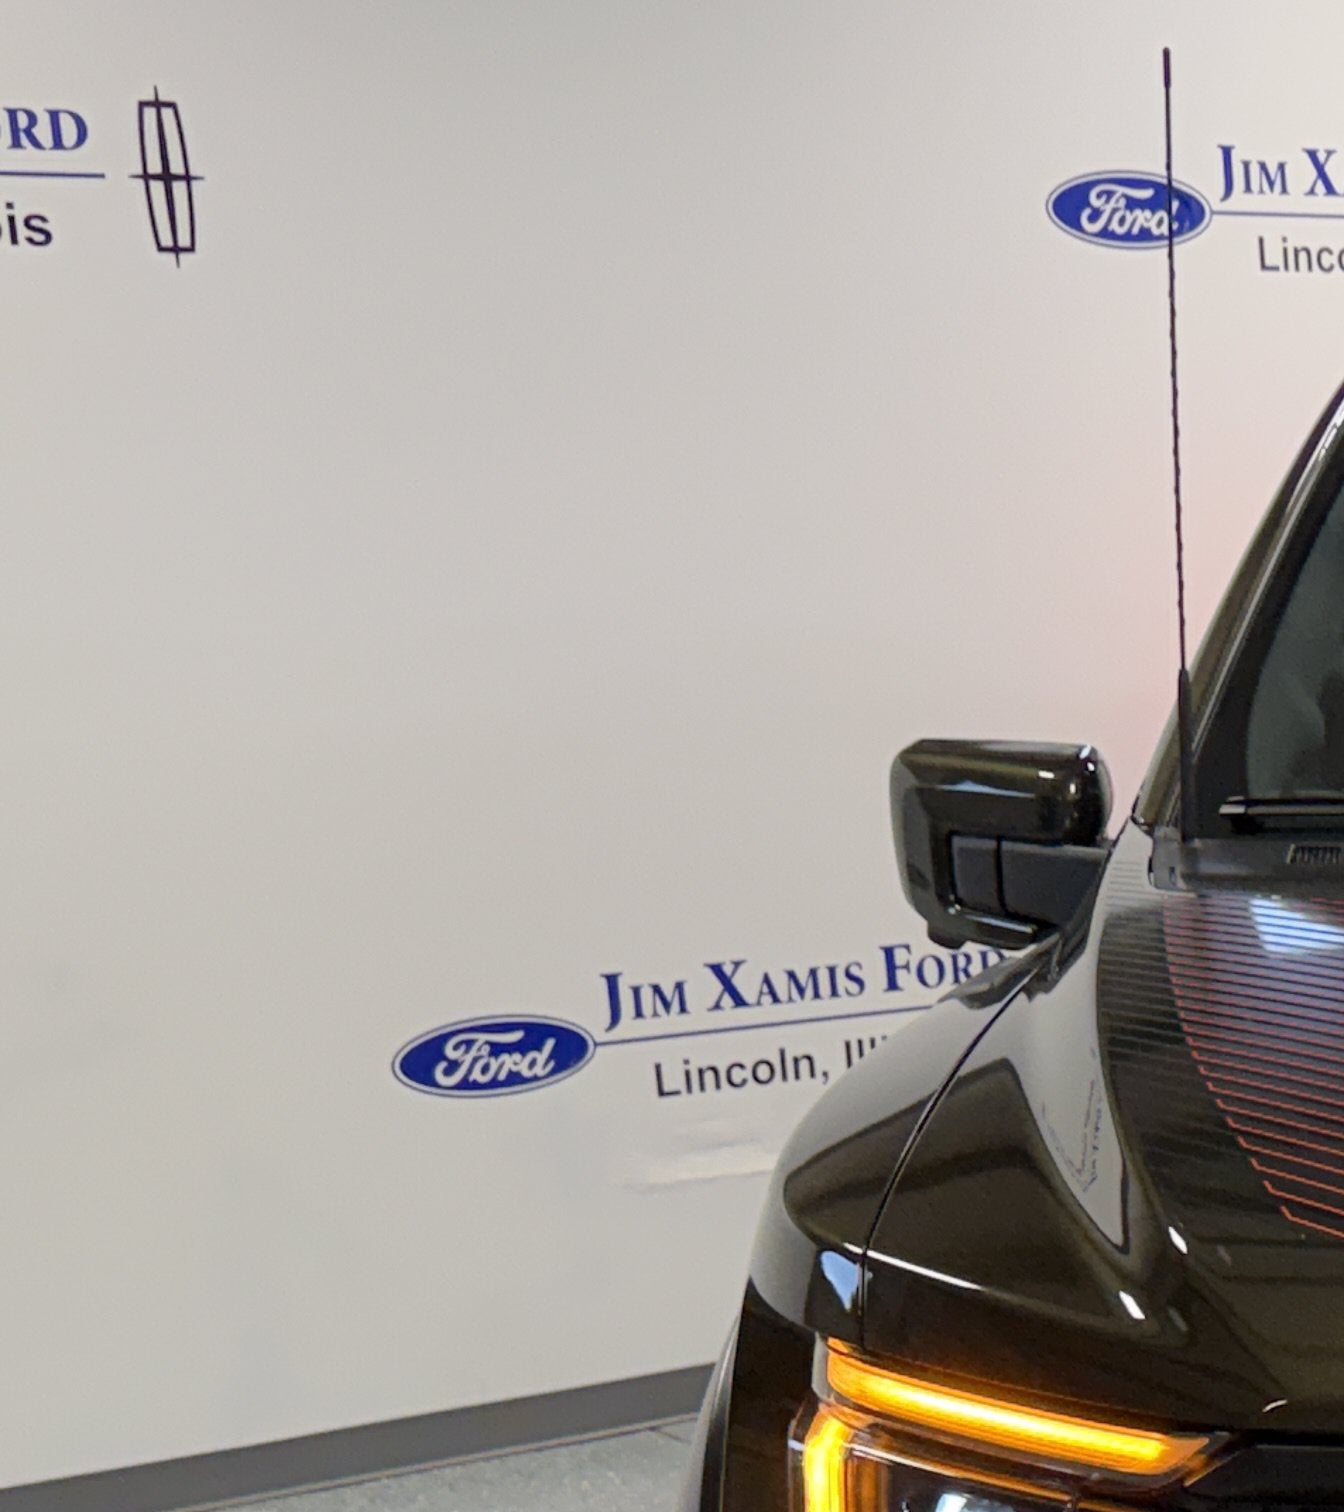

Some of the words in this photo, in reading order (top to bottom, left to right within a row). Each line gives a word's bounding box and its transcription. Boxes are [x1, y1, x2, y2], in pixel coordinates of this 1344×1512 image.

[0, 107, 89, 151] RD
[1216, 144, 1290, 203] JIM
[1079, 182, 1180, 236] Ford
[600, 971, 690, 1033] JIM
[702, 958, 866, 1012] XAMIS
[433, 1029, 557, 1088] Ford
[653, 1045, 830, 1099] Lincoln,
